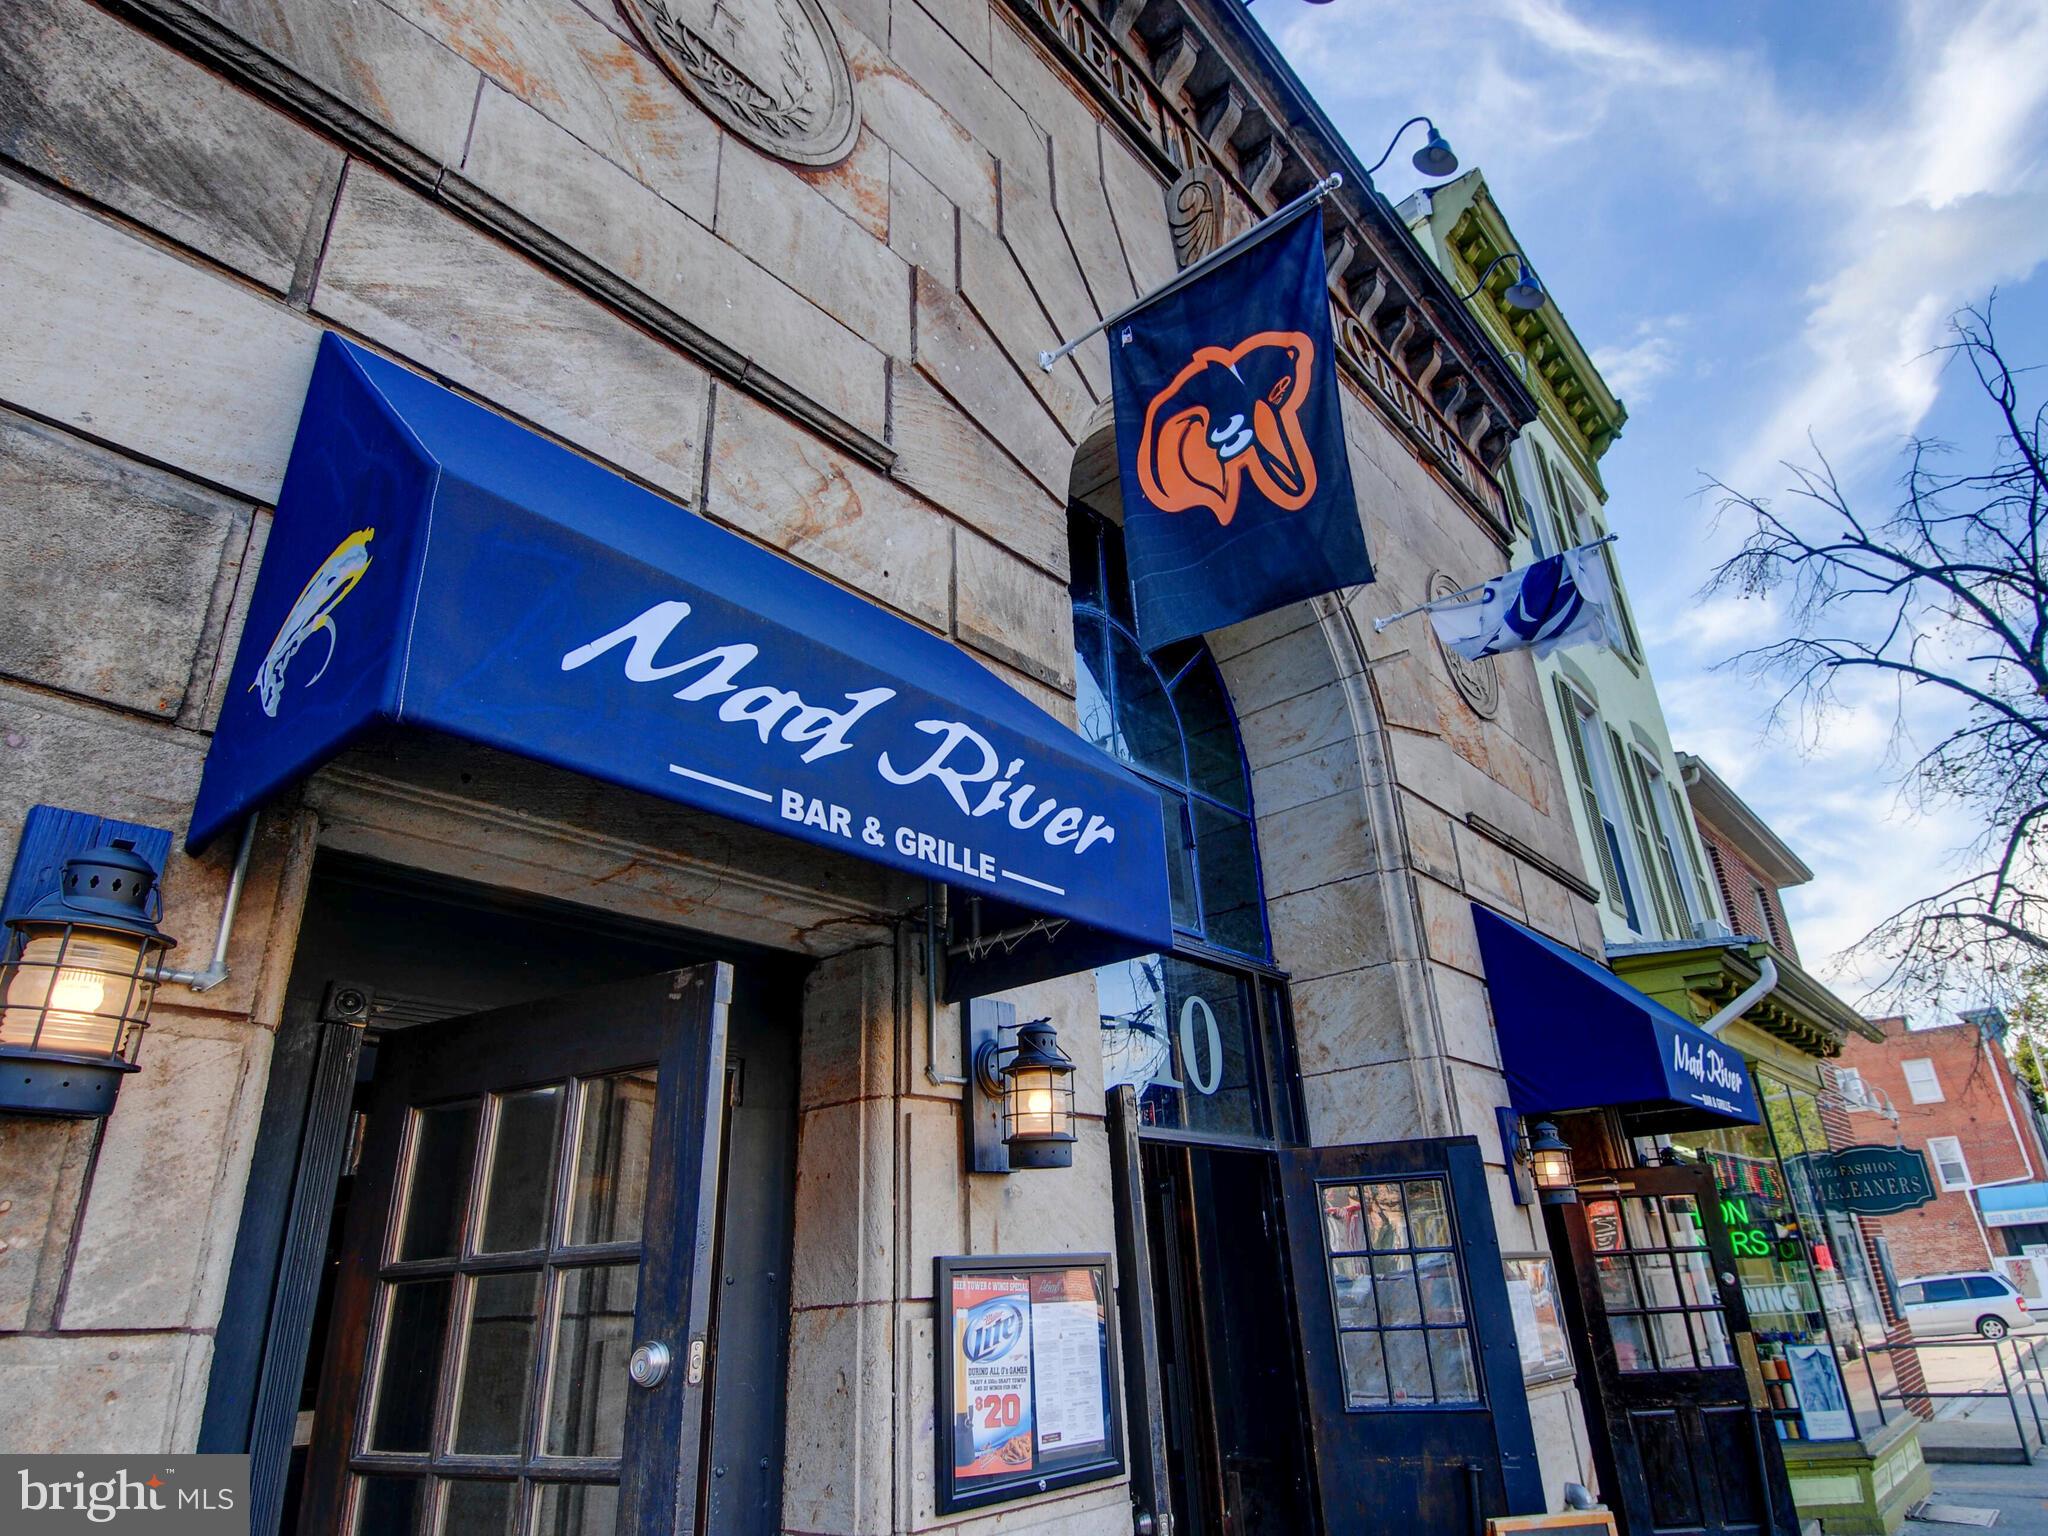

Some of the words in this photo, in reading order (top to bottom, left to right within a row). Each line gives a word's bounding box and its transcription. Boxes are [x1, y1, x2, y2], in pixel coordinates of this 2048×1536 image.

[1342, 317, 1464, 478] GRILLE
[561, 601, 896, 763] Mad
[878, 720, 1115, 854] River
[781, 789, 852, 840] BAR
[861, 816, 886, 847] &
[894, 826, 997, 883] GRILLE
[1674, 1034, 1705, 1083] Mad
[1706, 1049, 1743, 1093] River
[1839, 1161, 1898, 1178] FASHION
[990, 1366, 1000, 1376] ALL
[1009, 1366, 1028, 1375] GAMES
[975, 1393, 1021, 1429] $20
